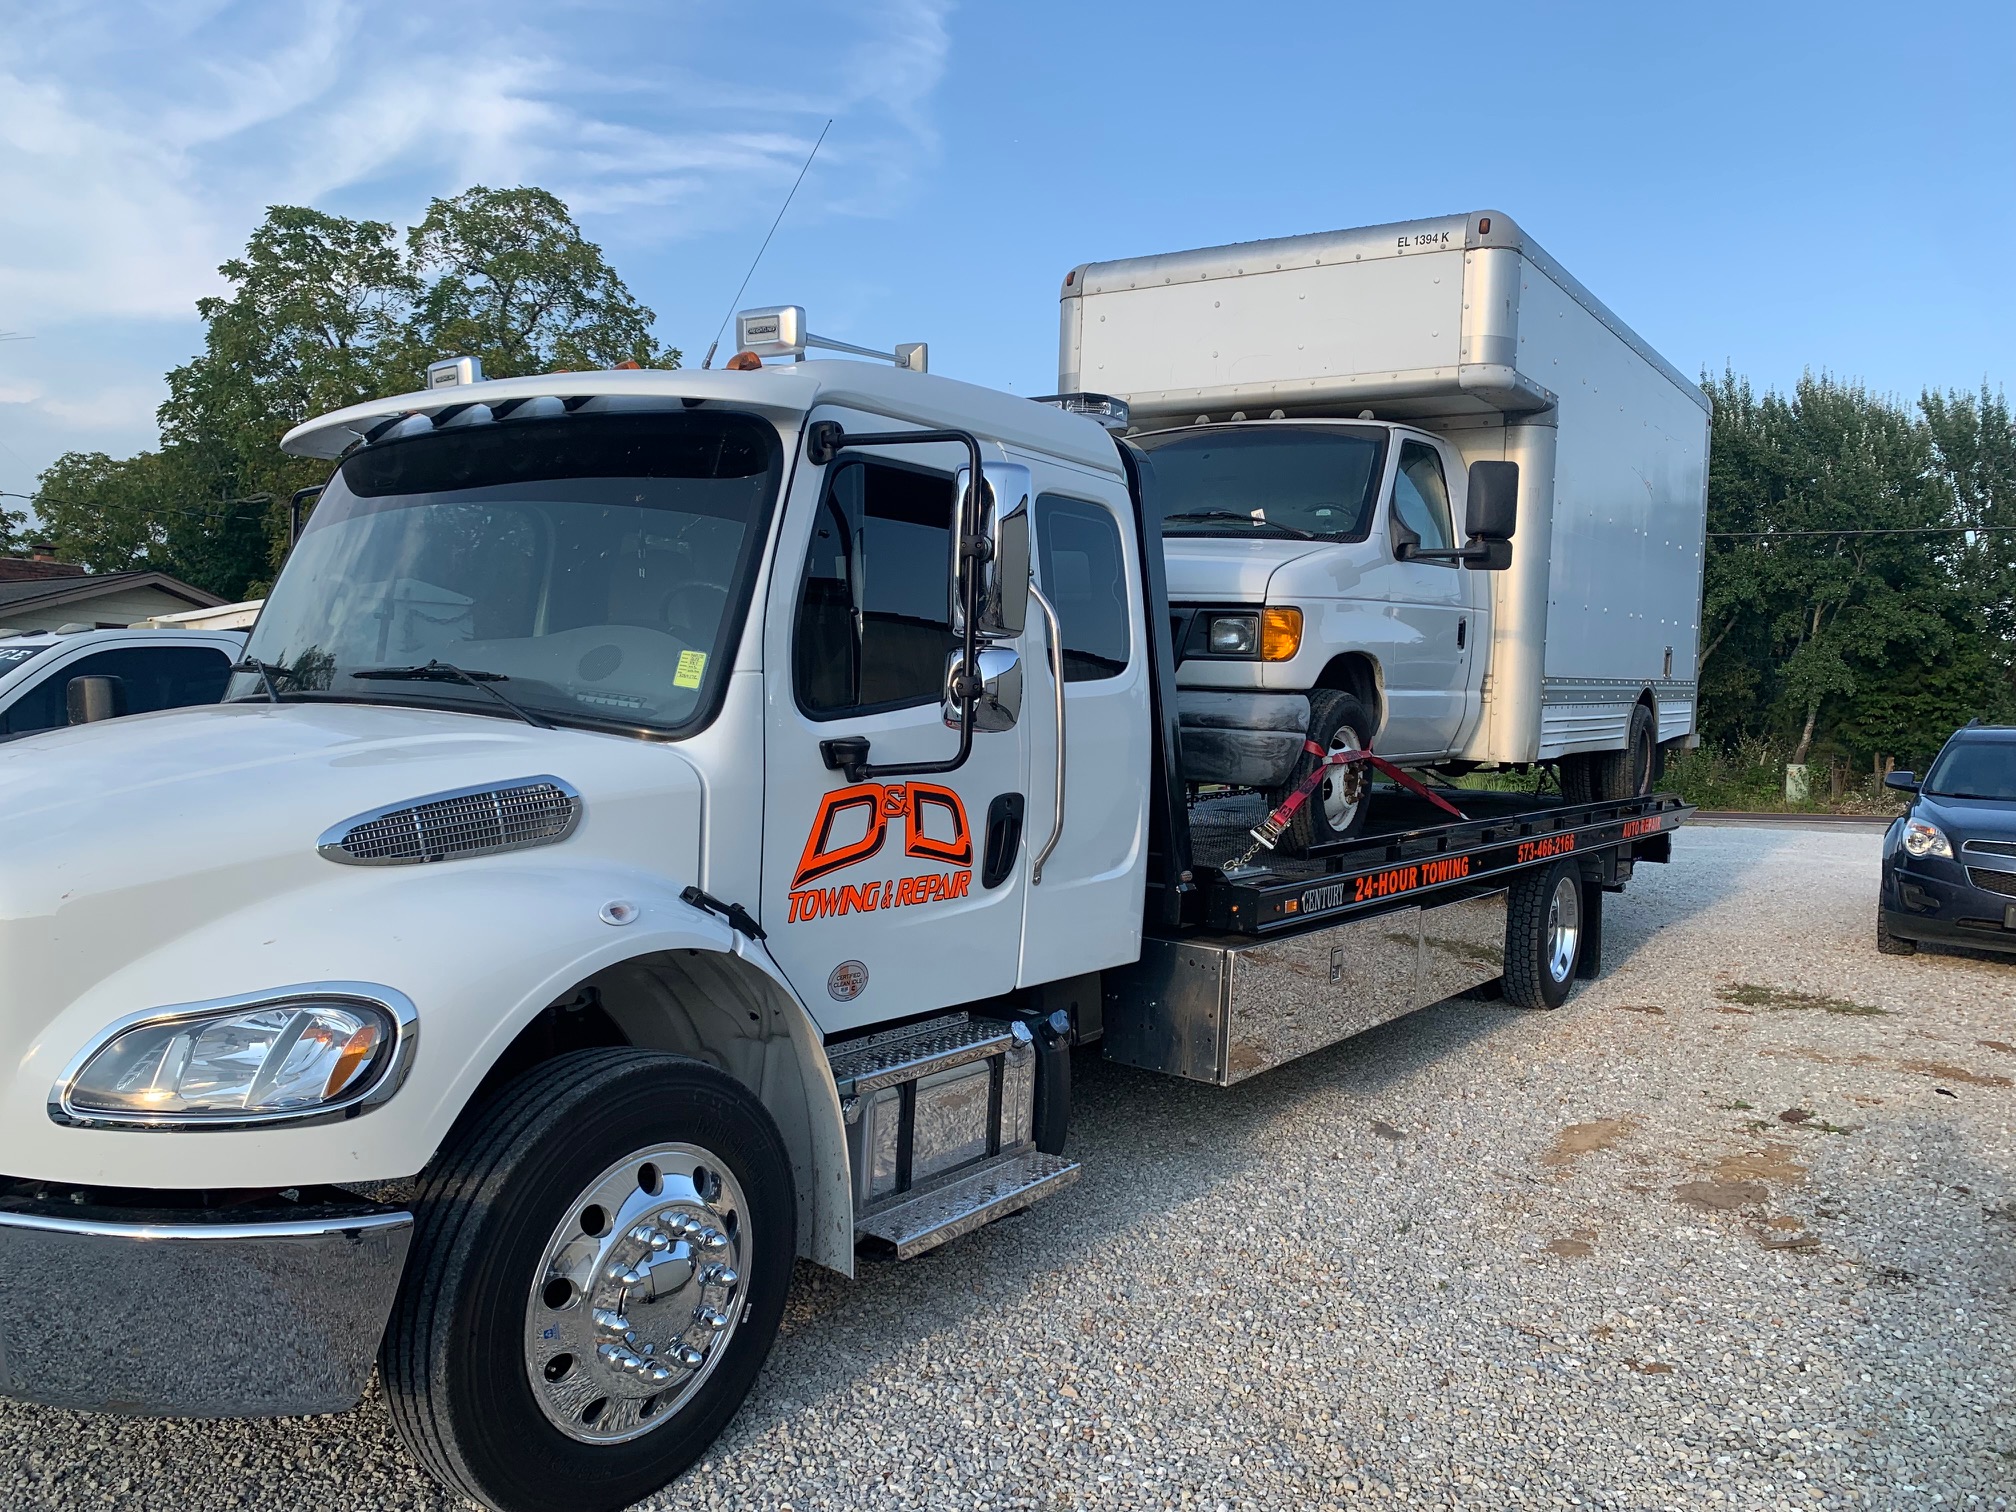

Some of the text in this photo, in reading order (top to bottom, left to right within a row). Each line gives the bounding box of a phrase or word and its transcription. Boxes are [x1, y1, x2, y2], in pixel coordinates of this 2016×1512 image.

[1397, 232, 1450, 248] EL 1394 K
[0, 648, 34, 660] CE
[790, 781, 973, 890] D&D
[1622, 816, 1662, 838] AUTO REPAIR
[1517, 833, 1575, 863] 573-466-2166
[1355, 856, 1469, 902] 24-HOUR TOWING
[788, 870, 972, 923] TOWING & REPAIR
[1302, 883, 1344, 913] CENTURY
[833, 980, 850, 989] CLEAN
[836, 972, 862, 981] CERTIFIED
